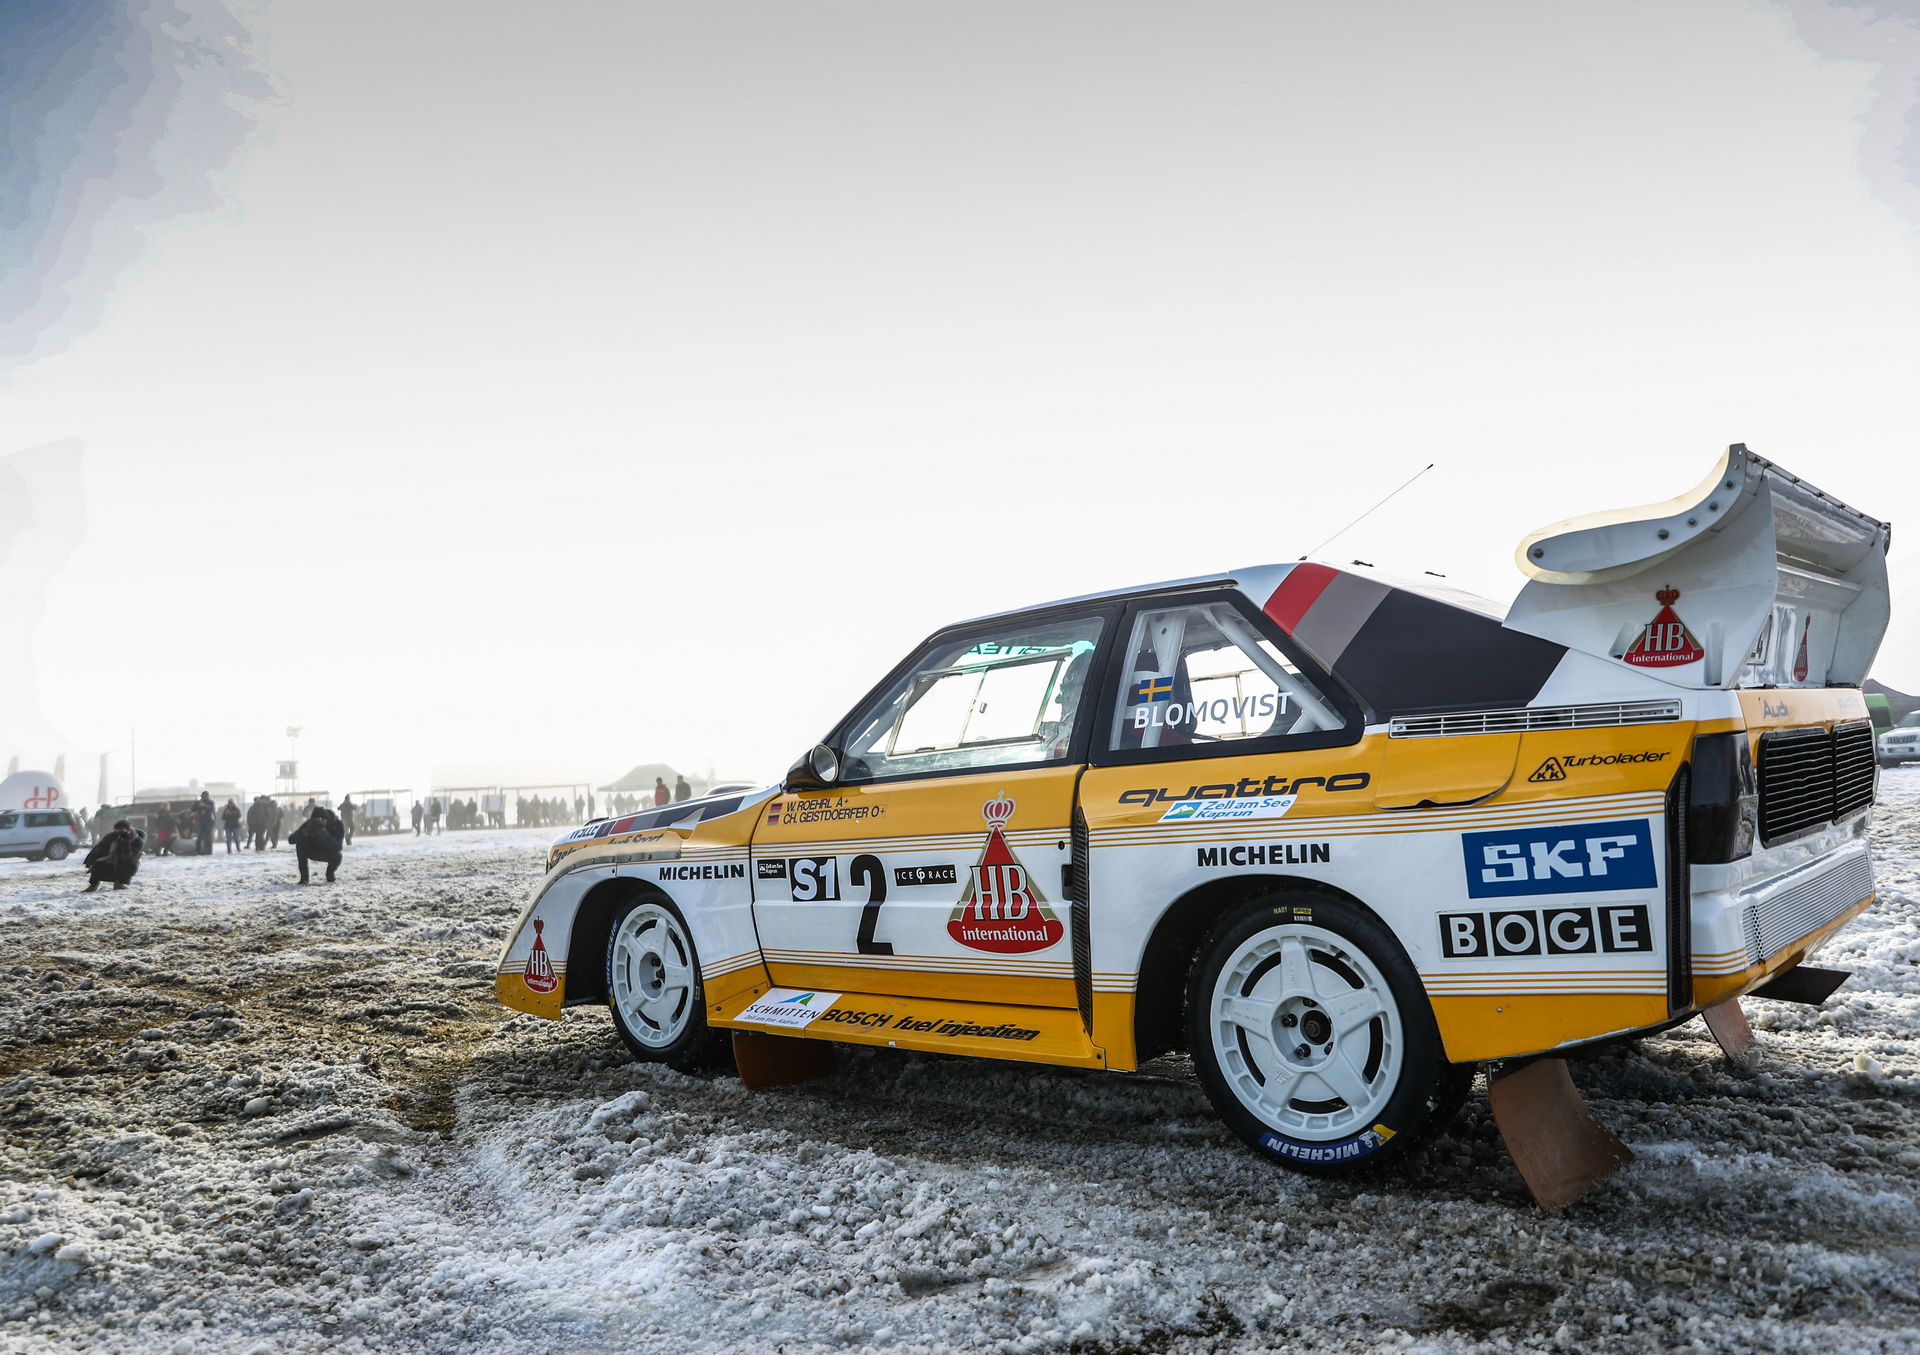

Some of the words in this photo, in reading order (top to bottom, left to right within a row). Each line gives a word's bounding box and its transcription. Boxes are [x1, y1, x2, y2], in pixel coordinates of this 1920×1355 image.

[1644, 622, 1686, 652] HB
[1632, 652, 1694, 663] international
[1134, 691, 1294, 730] BLOMQVIST
[1763, 699, 1790, 719] Audi
[1562, 751, 1671, 768] Turbolader
[1118, 772, 1371, 808] quattro
[797, 798, 832, 811] ROEHRL
[800, 806, 869, 823] GEISTDOERFER
[1195, 810, 1253, 819] Kaprun
[1203, 800, 1233, 810] Zell
[1235, 801, 1259, 809] am
[1260, 798, 1291, 808] See
[1197, 843, 1331, 867] MICHELIN
[1481, 835, 1638, 882] SKF
[659, 863, 745, 881] MICHELIN
[793, 858, 836, 901] S1
[896, 871, 914, 880] ICE
[928, 870, 955, 879] RACE
[970, 863, 1031, 921] HB
[849, 854, 895, 956] 2
[962, 925, 1049, 942] international
[1449, 909, 1639, 954] BOGE
[531, 950, 548, 976] HB
[746, 1004, 821, 1019] SCHMITTEN
[820, 1009, 893, 1028] BOSCH
[892, 1016, 944, 1033] fuel
[935, 1020, 1041, 1042] injection
[1266, 1136, 1360, 1162] MICHELIN
